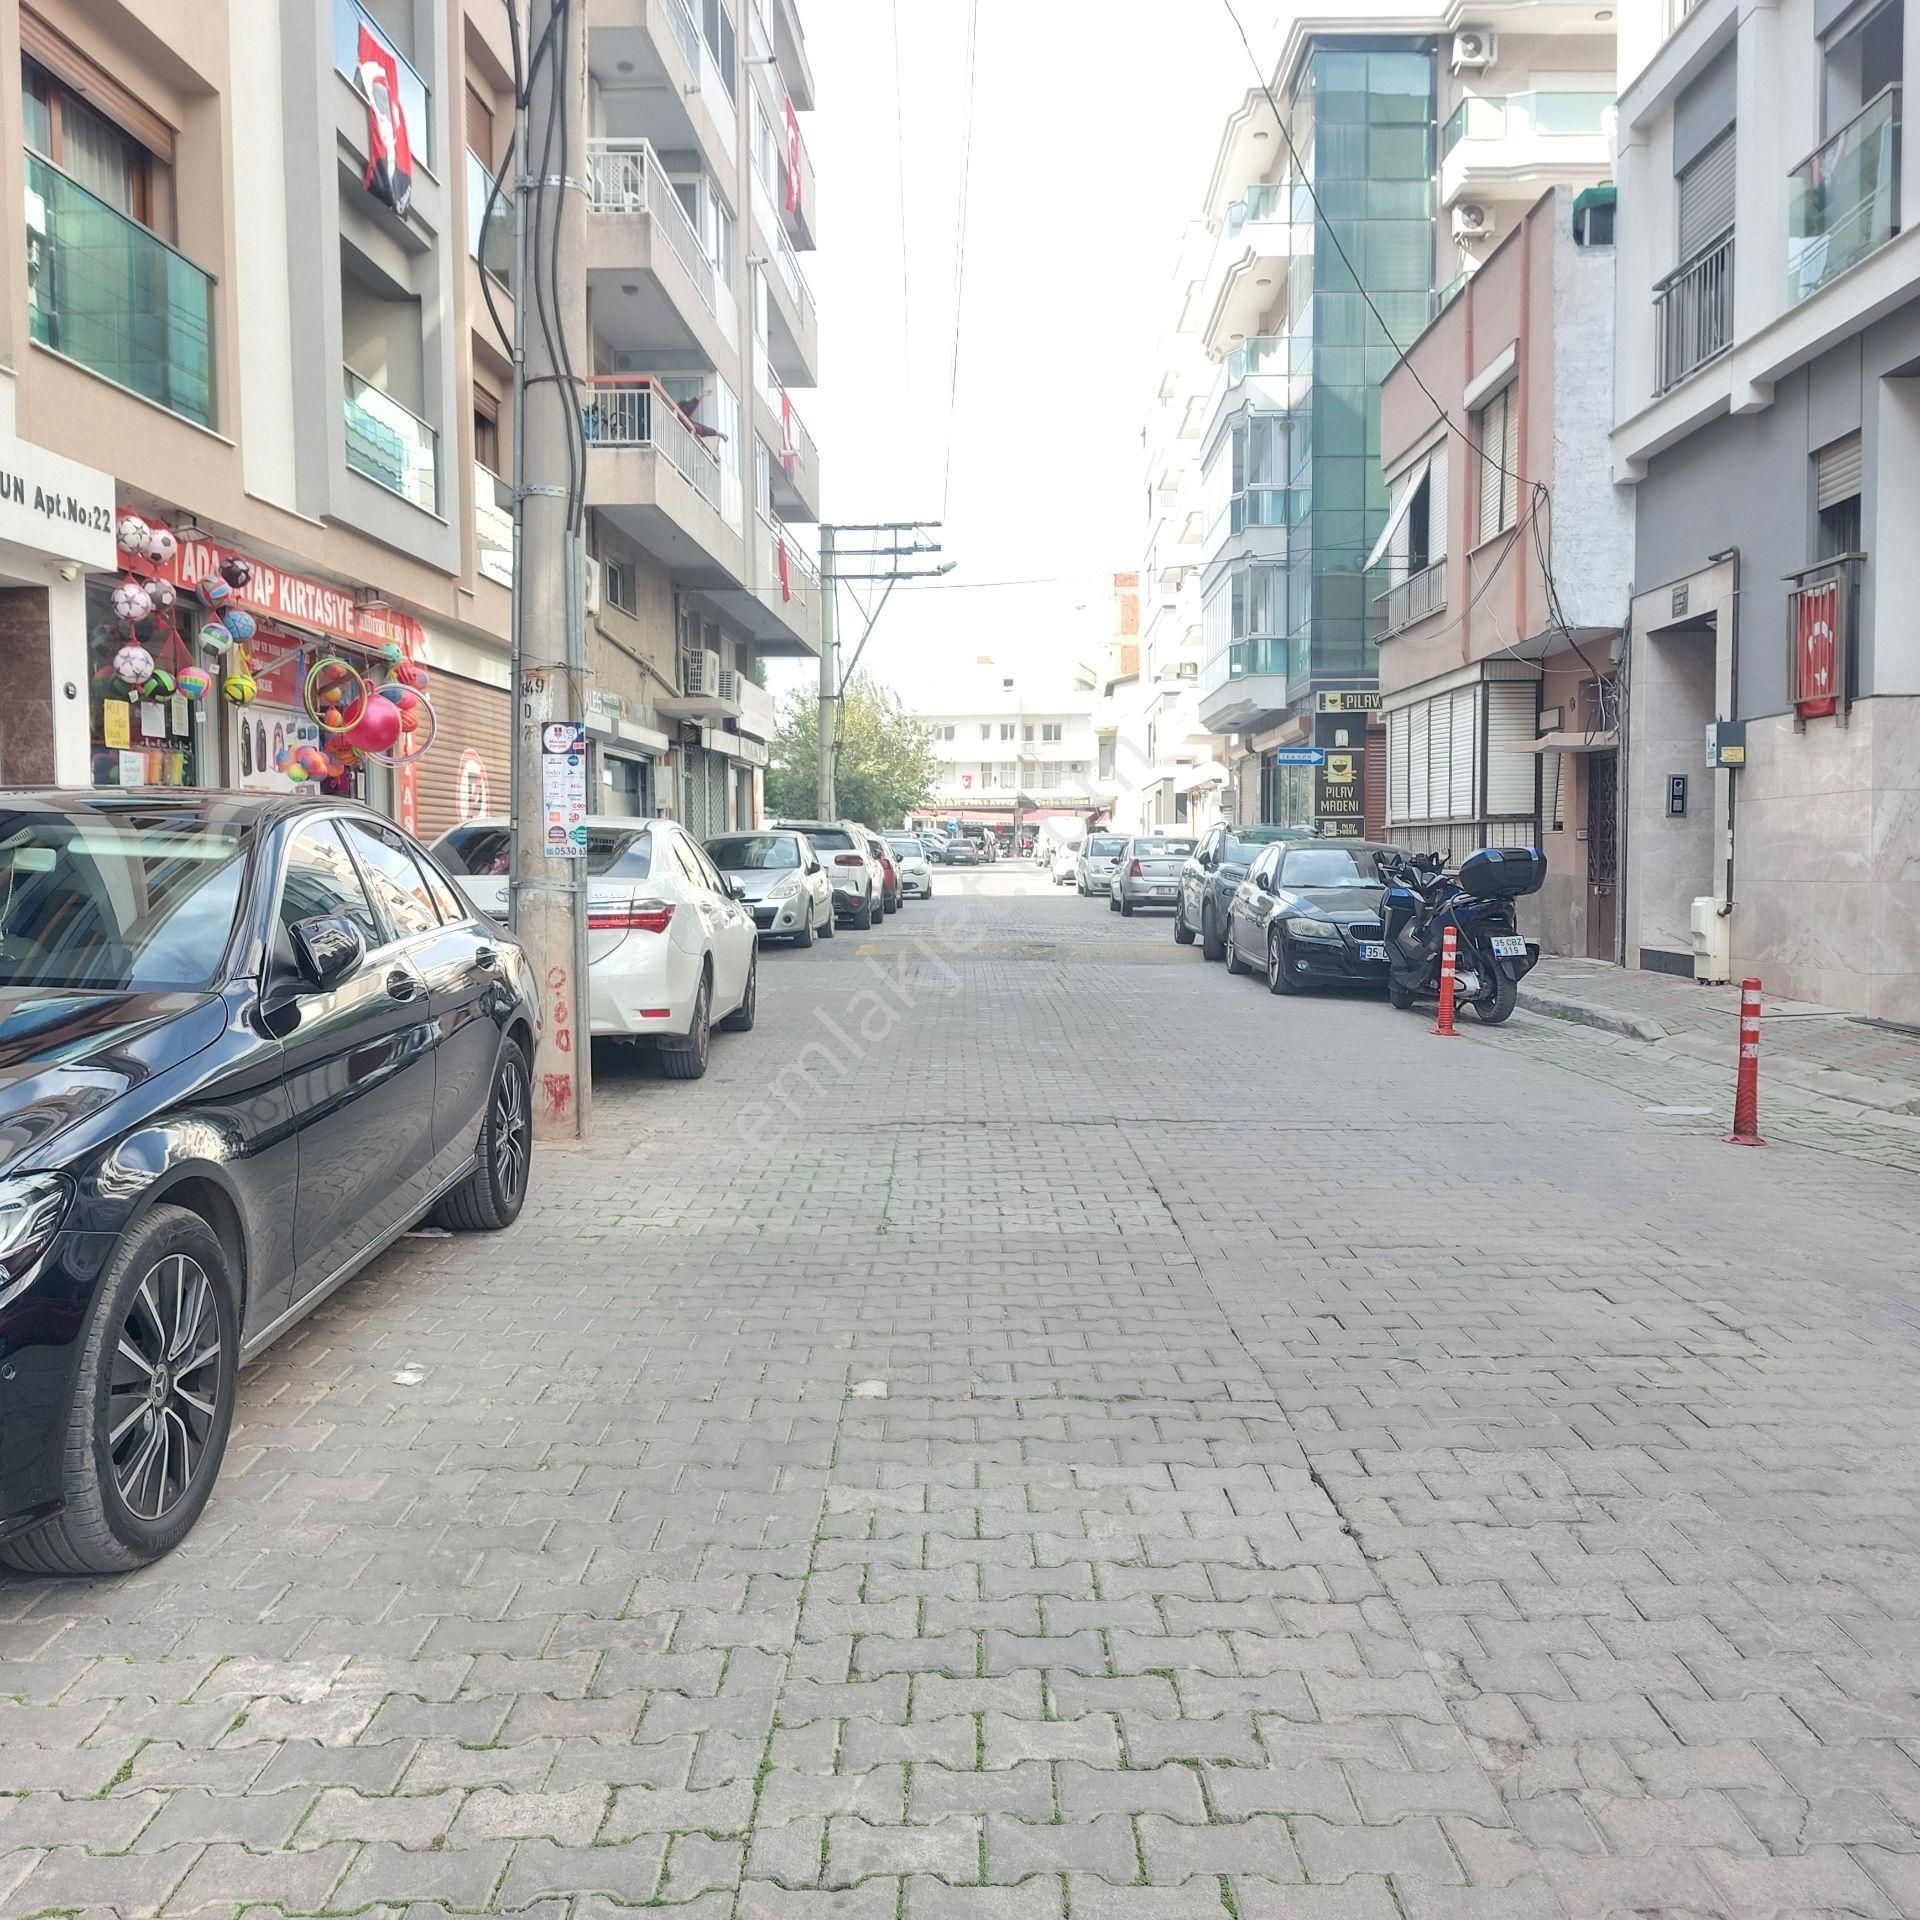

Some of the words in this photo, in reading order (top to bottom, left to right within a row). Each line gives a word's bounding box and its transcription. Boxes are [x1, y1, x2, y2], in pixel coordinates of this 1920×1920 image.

[33, 485, 111, 533] Apt.No:22
[1325, 786, 1354, 799] PILAV
[554, 847, 577, 856] 0530
[1494, 938, 1505, 947] 35
[1367, 947, 1378, 957] 35
[1503, 946, 1519, 955] 319
